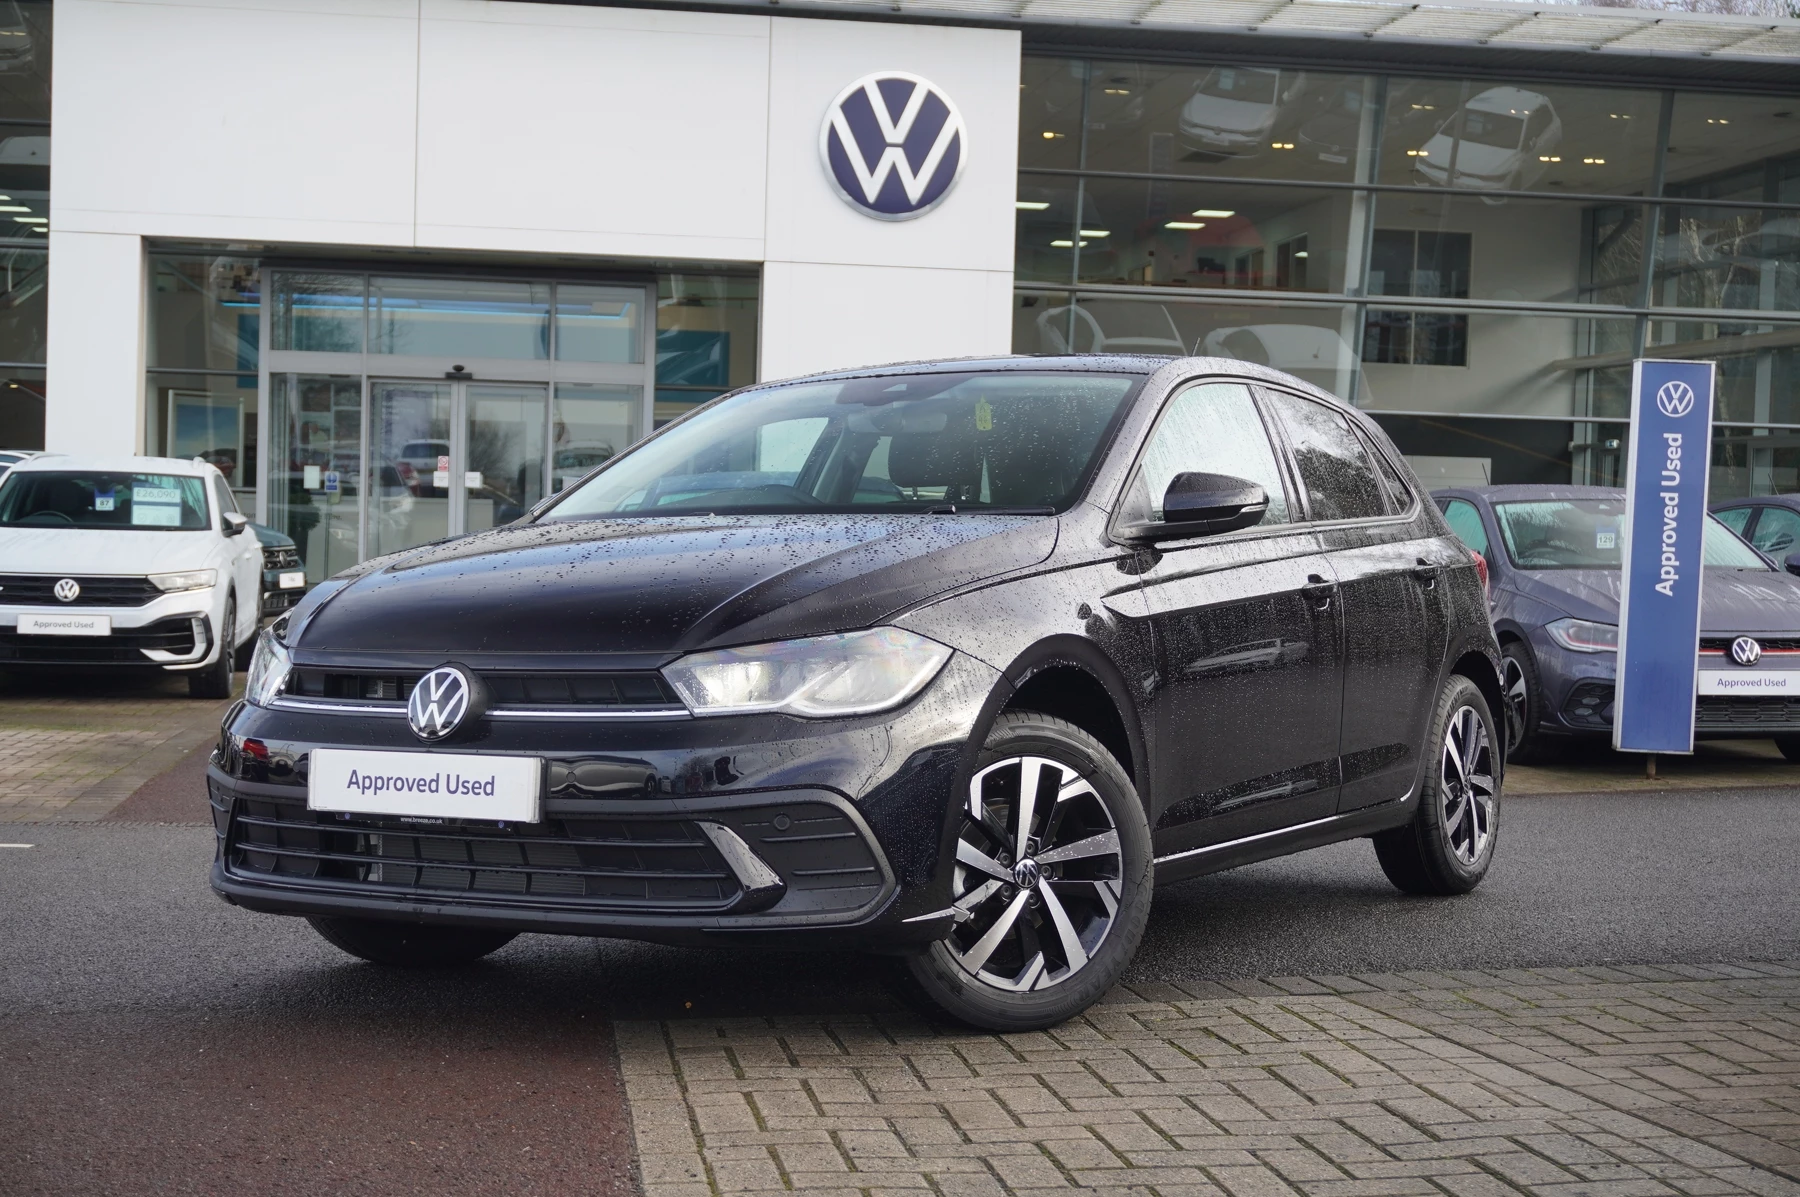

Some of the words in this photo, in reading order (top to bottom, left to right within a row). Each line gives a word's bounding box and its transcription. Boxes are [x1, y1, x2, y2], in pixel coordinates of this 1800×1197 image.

[1661, 433, 1682, 486] Used
[1655, 491, 1679, 597] Approved
[33, 620, 72, 630] Approved
[74, 620, 94, 629] Used
[1716, 677, 1762, 689] Approved
[1764, 677, 1786, 688] Used
[347, 769, 440, 796] Approved
[445, 773, 495, 797] Used
[400, 816, 443, 824] www.breeze.co.uk
